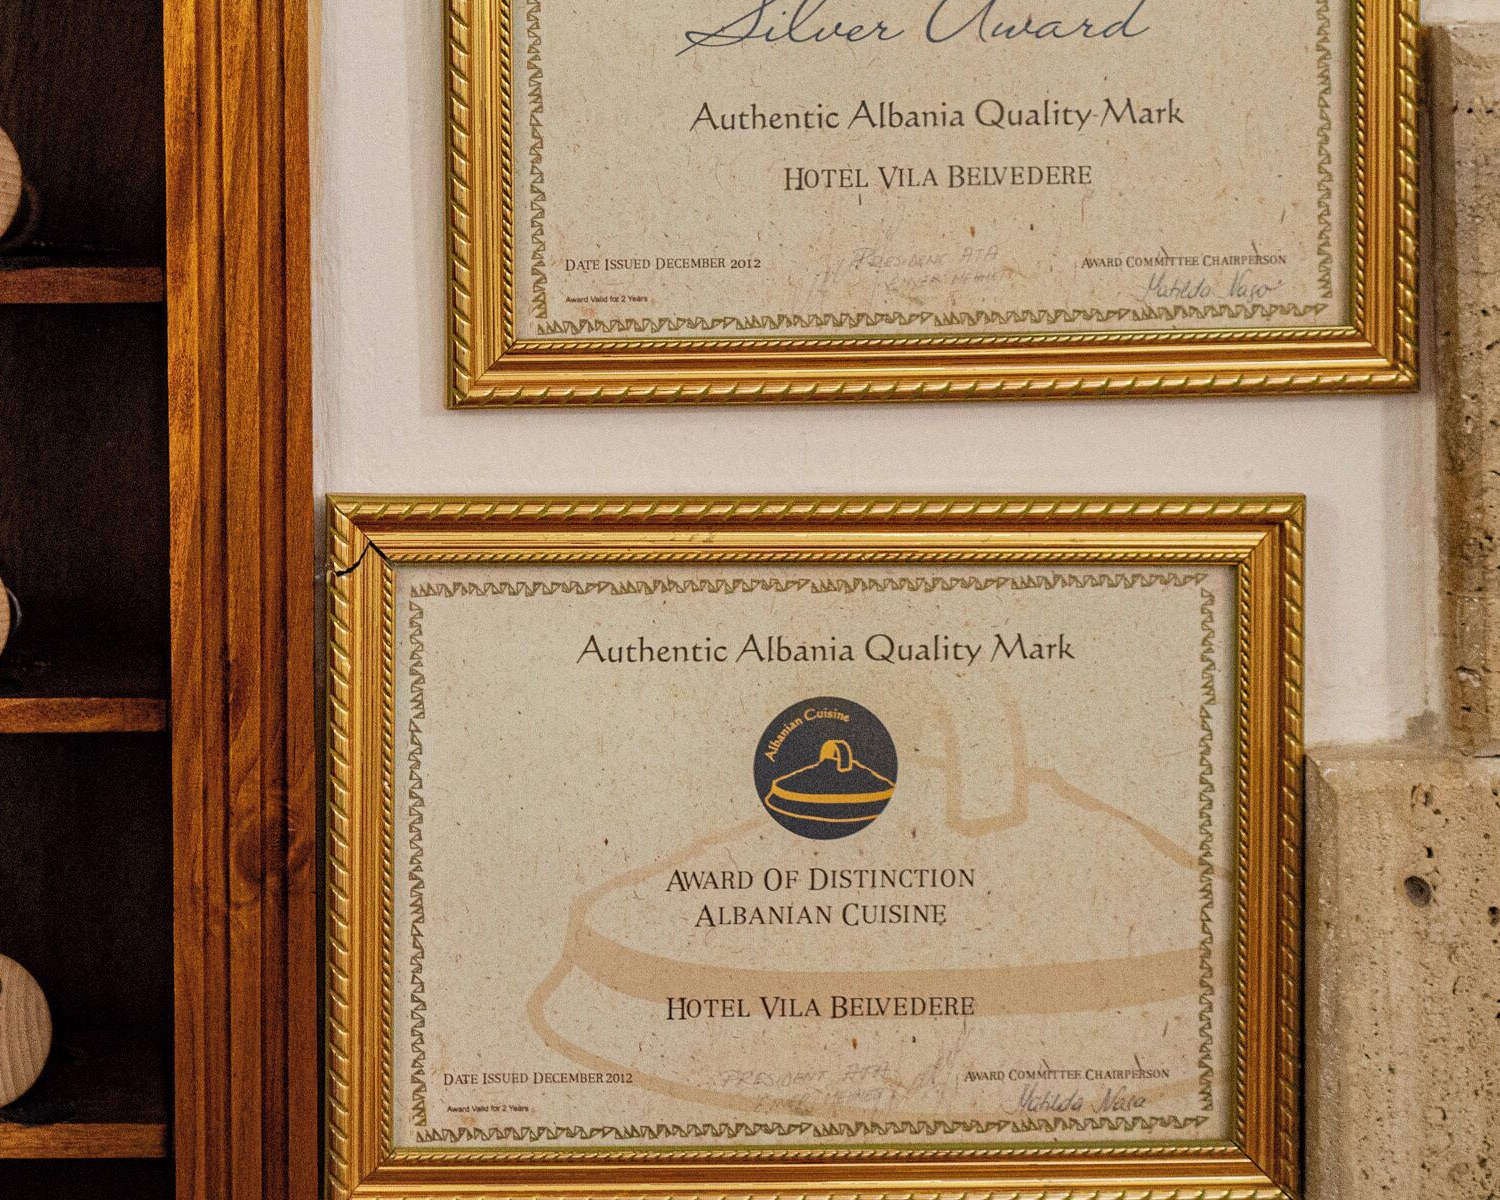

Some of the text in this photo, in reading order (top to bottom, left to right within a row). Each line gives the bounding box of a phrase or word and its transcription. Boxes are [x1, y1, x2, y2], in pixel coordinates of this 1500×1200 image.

[689, 97, 1185, 132] Authentic Albania Quality Mark
[783, 164, 1093, 191] HOTEL VILA BELVEDERE
[565, 257, 762, 272] DATE ISSUED DECEMBER 2012
[1081, 254, 1288, 269] AWARD COMMITTEE CHAIRPERSON
[576, 632, 1076, 667] Authentic Albania Quality Mark
[764, 707, 851, 763] Albanian Cuisine
[665, 867, 976, 892] AWARD OF DISTINCTION
[694, 902, 948, 927] ALBANIAN CUISINE
[665, 994, 976, 1021] HOTEL VILA BELVEDERE
[443, 1071, 634, 1086] DATE ISSUED DECEMBER 2012
[963, 1067, 1171, 1082] AWARD COMMITTEE CHAIRPERSON
